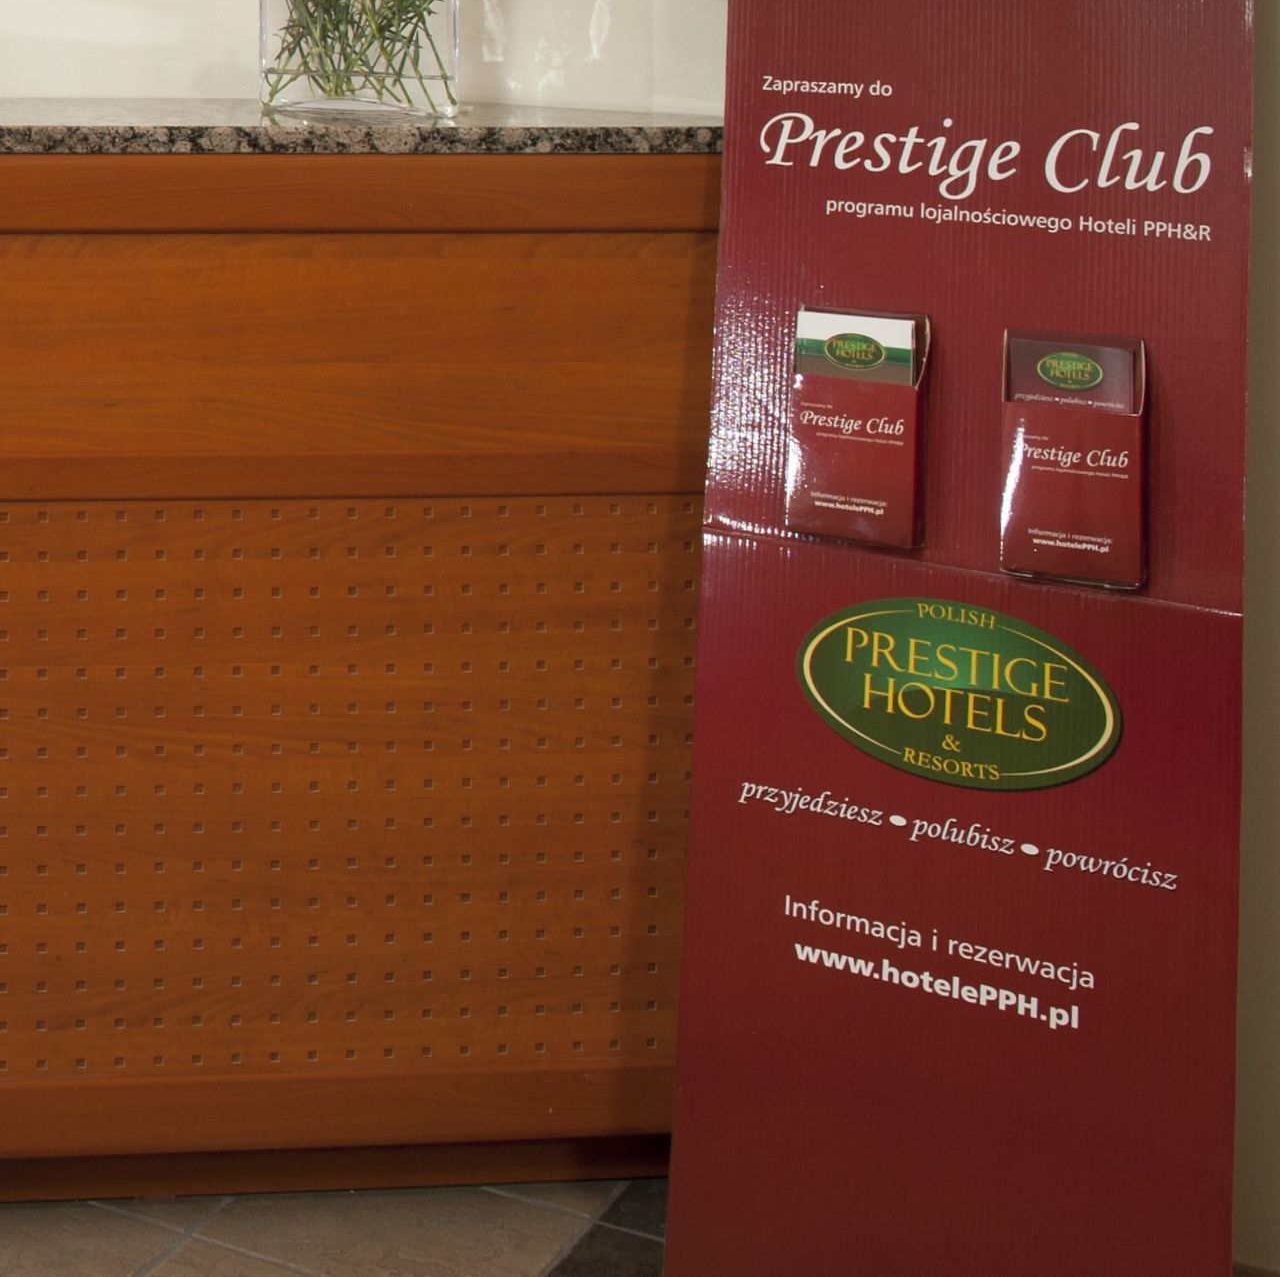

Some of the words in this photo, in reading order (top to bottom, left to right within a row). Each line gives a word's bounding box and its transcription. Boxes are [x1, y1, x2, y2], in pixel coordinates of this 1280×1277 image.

[762, 74, 865, 100] Zapraszamy
[869, 79, 894, 98] do
[759, 111, 1021, 201] Prestige
[1043, 121, 1216, 195] Club
[826, 196, 915, 220] programu
[919, 202, 1073, 233] lojalnościowego
[1078, 214, 1138, 237] Hoteli
[1143, 219, 1213, 243] PPH&R
[799, 410, 862, 435] Prestige
[866, 417, 905, 436] Club
[1086, 448, 1129, 468] Club
[916, 601, 997, 631] POLISH
[844, 625, 1070, 704] PRESTIGE
[861, 673, 1048, 742] HOTELS
[902, 746, 1001, 782] RESORTS
[941, 733, 961, 753] &
[738, 778, 884, 828] przyjedziesz
[909, 817, 1016, 857] polubisz
[1043, 843, 1179, 892] powrócisz
[784, 893, 923, 951] Informacja
[931, 928, 939, 952] i
[947, 936, 1096, 990] rezerwacja
[794, 942, 1081, 1030] www.hotelePPH.pl
